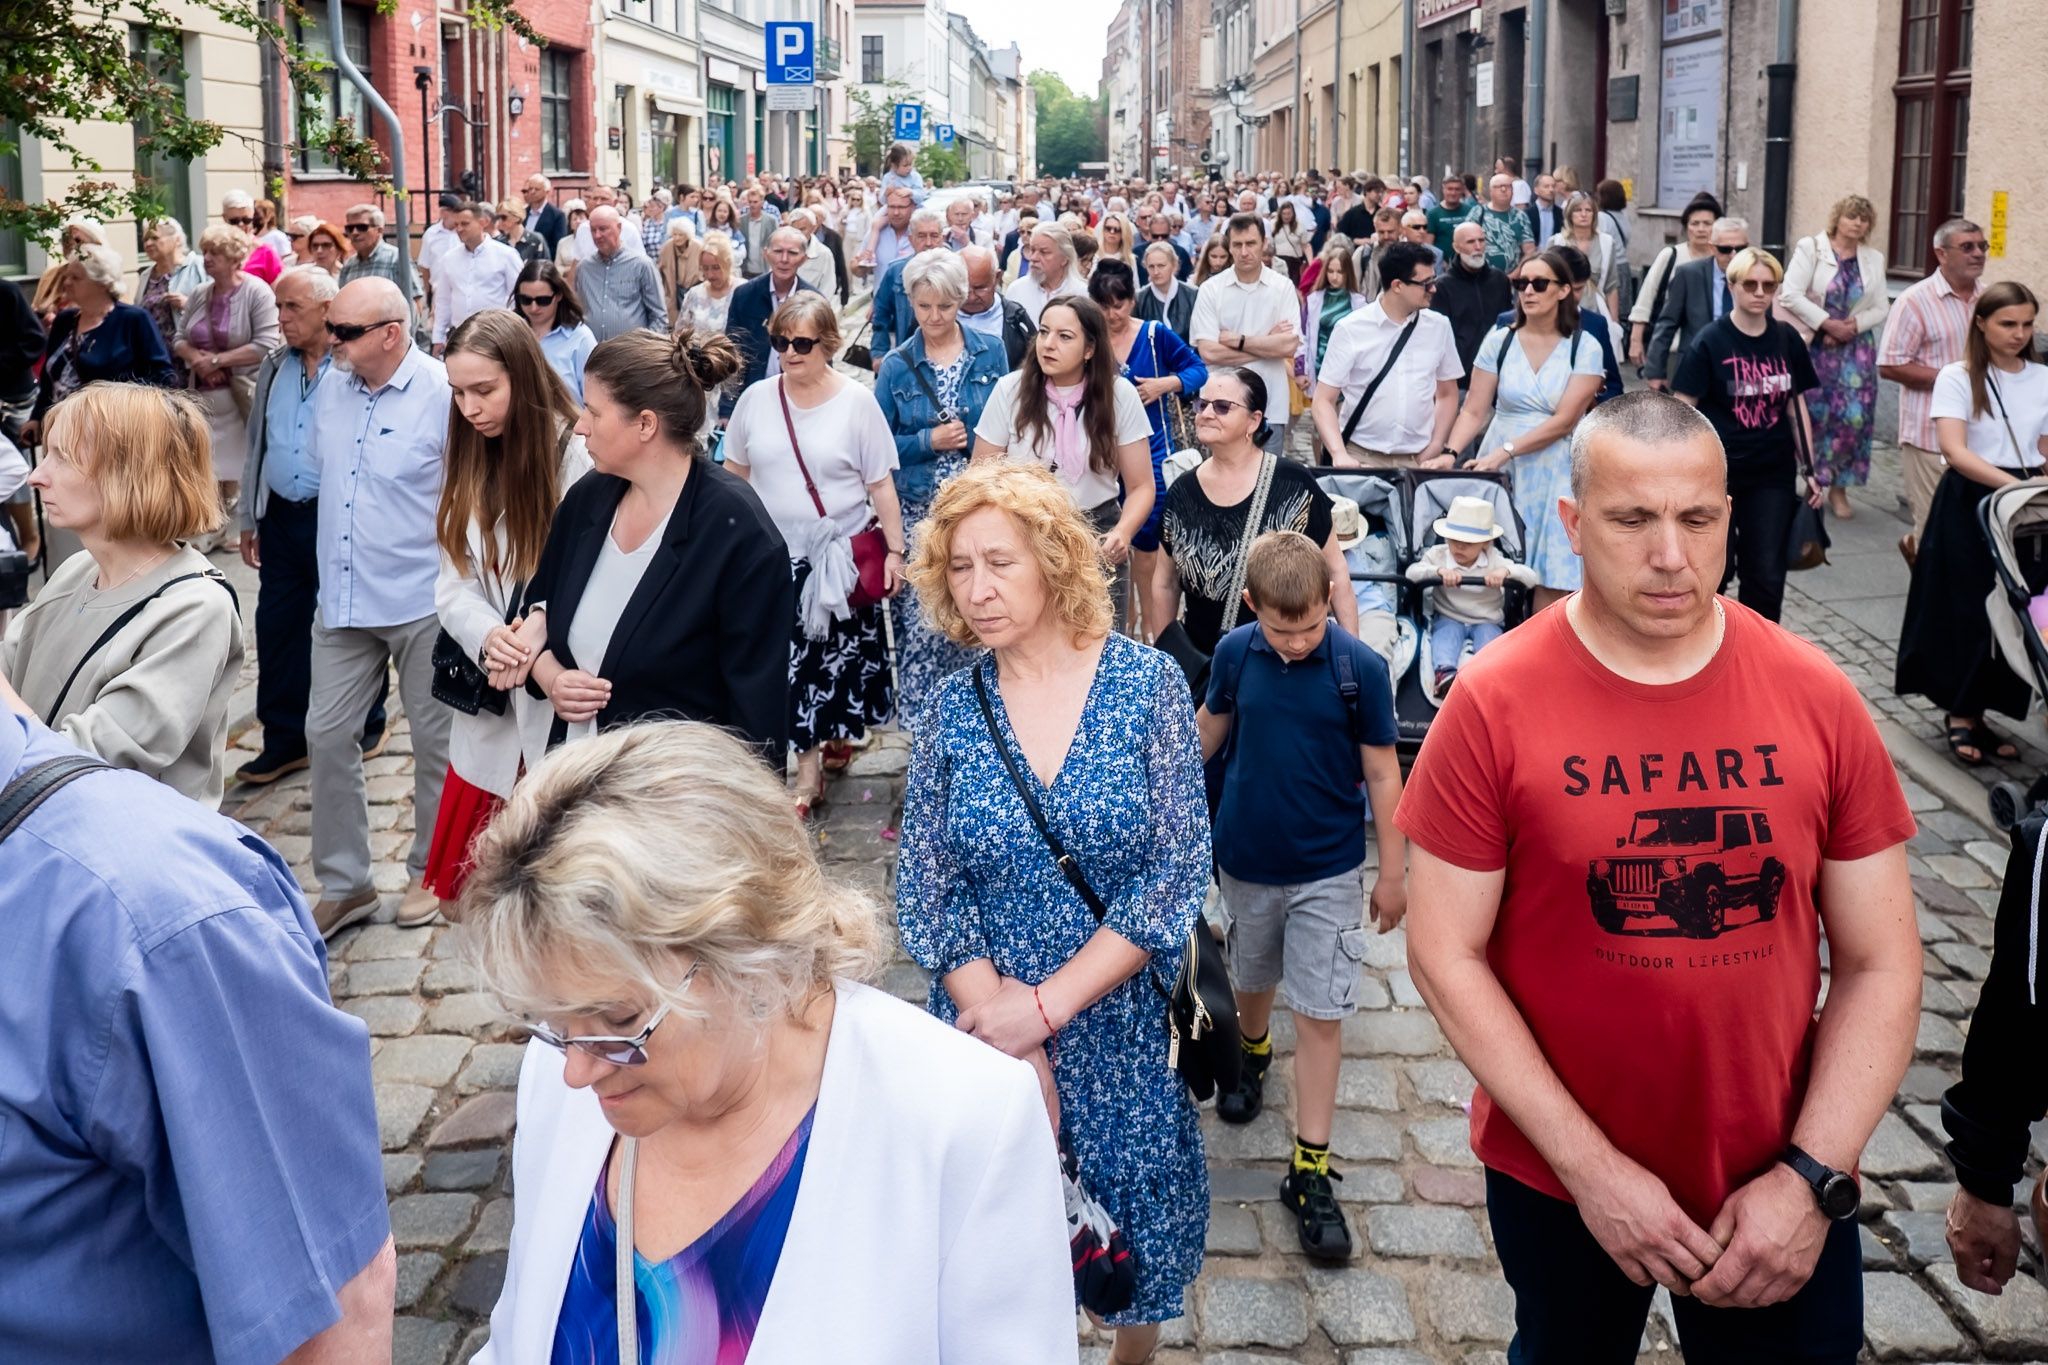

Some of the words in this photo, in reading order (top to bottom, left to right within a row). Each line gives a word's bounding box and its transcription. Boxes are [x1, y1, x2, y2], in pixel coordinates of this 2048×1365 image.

[776, 26, 805, 66] P
[901, 107, 917, 129] P
[939, 126, 952, 142] P
[1563, 744, 1784, 796] SAFARI
[1595, 948, 1674, 969] OUTDOOR
[1688, 943, 1773, 968] LIFESTYLE
